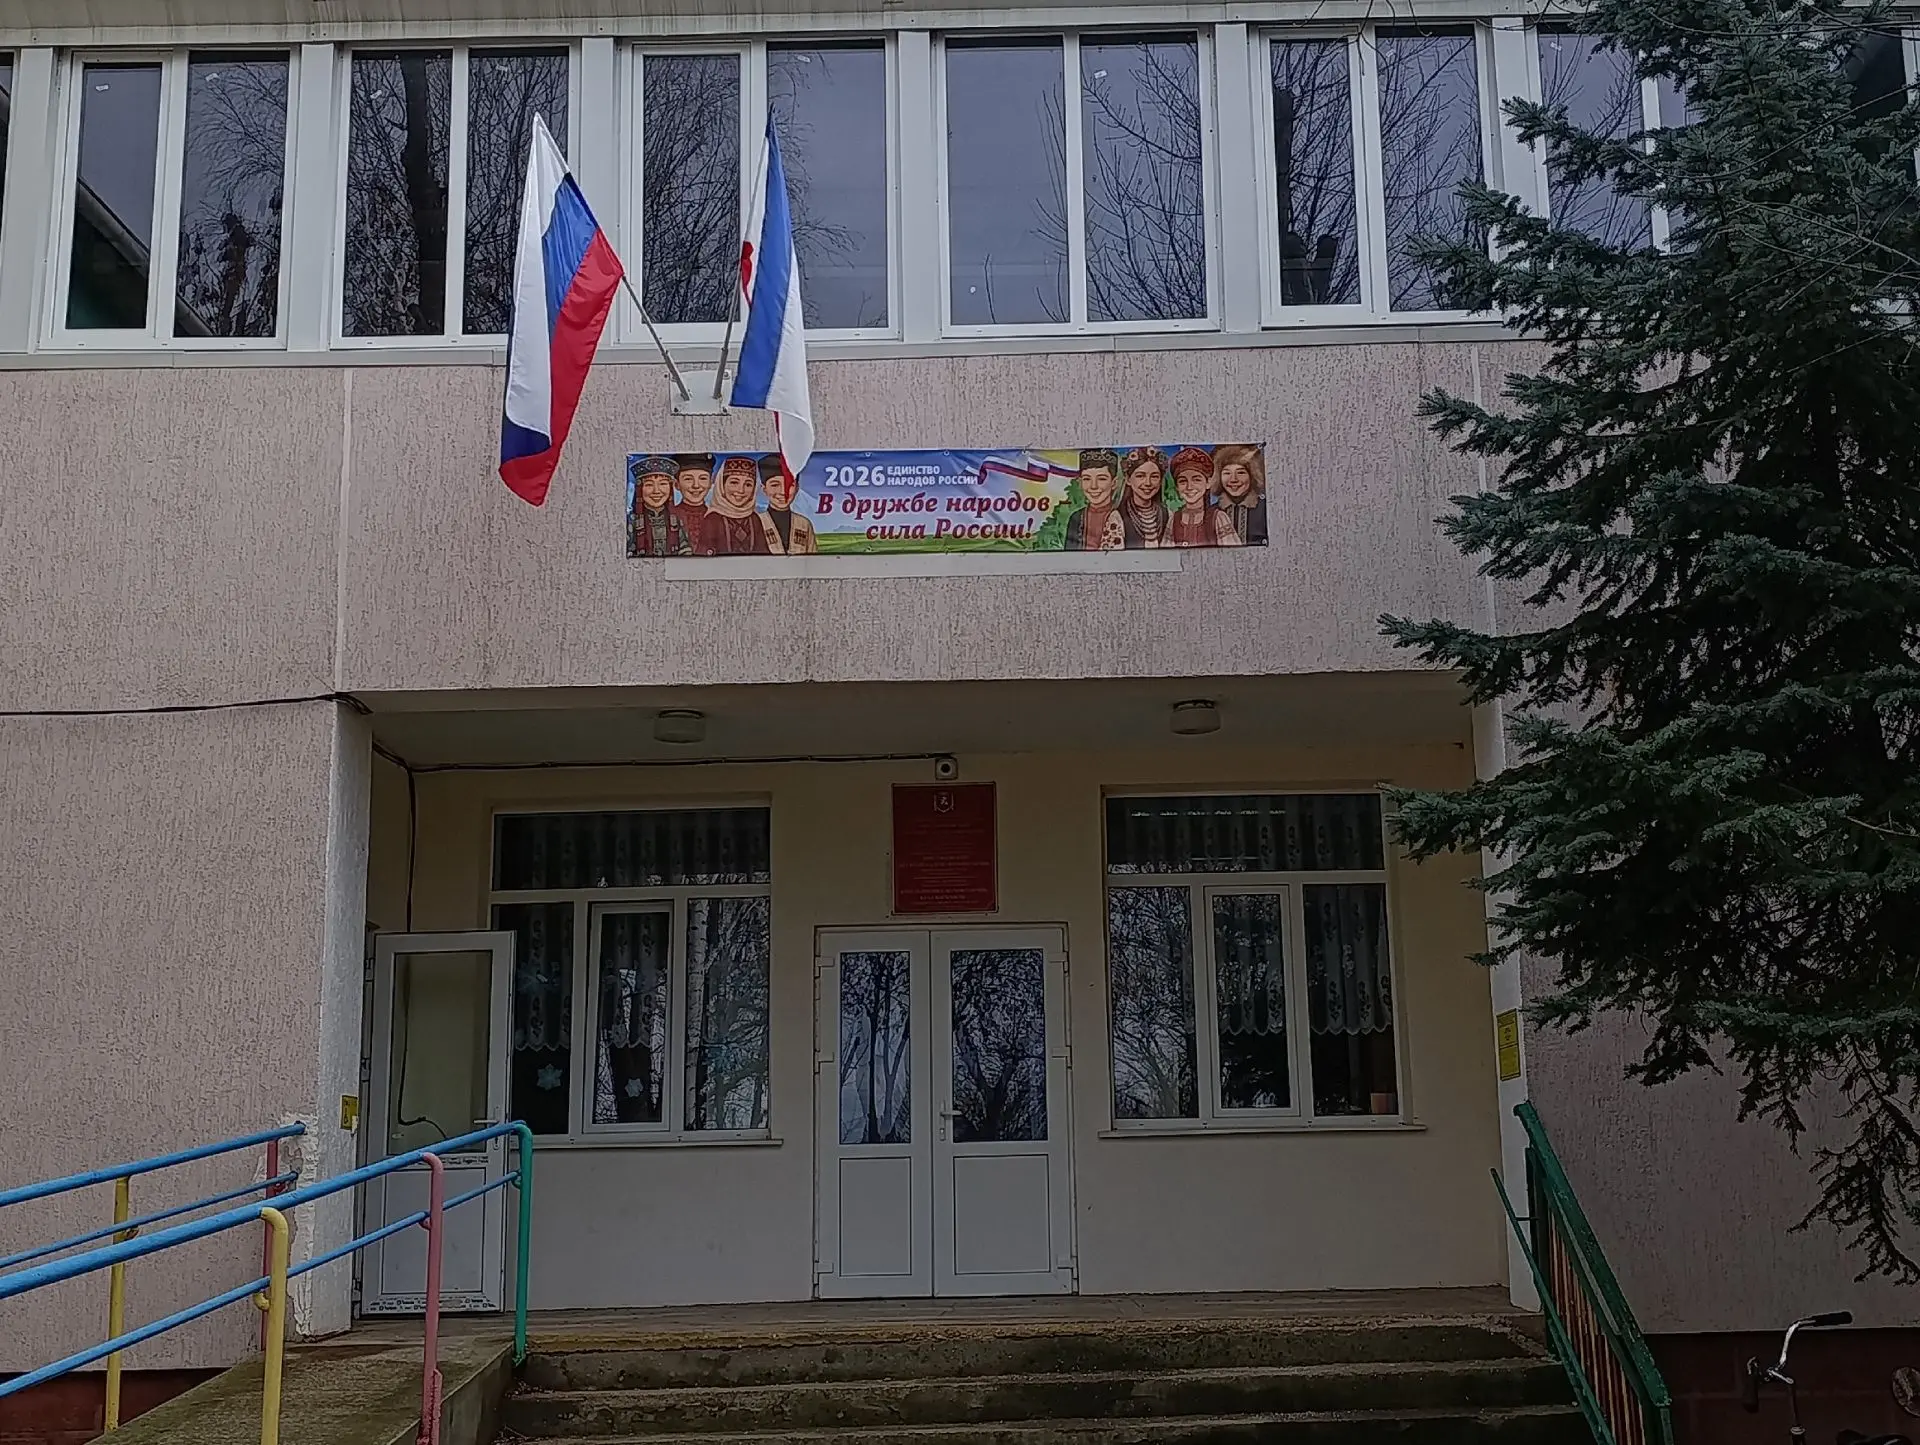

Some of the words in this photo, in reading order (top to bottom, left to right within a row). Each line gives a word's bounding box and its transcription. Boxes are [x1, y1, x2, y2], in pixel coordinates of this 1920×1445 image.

[824, 466, 885, 486] 2026
[887, 466, 940, 475] ЕДИНСТВО
[887, 475, 936, 486] НАРОДОВ
[938, 475, 979, 485] РОССИИ
[815, 493, 833, 514] В
[842, 491, 938, 519] дружбе
[946, 491, 1050, 518] народов
[866, 526, 926, 540] сила
[934, 518, 1034, 540] России!
